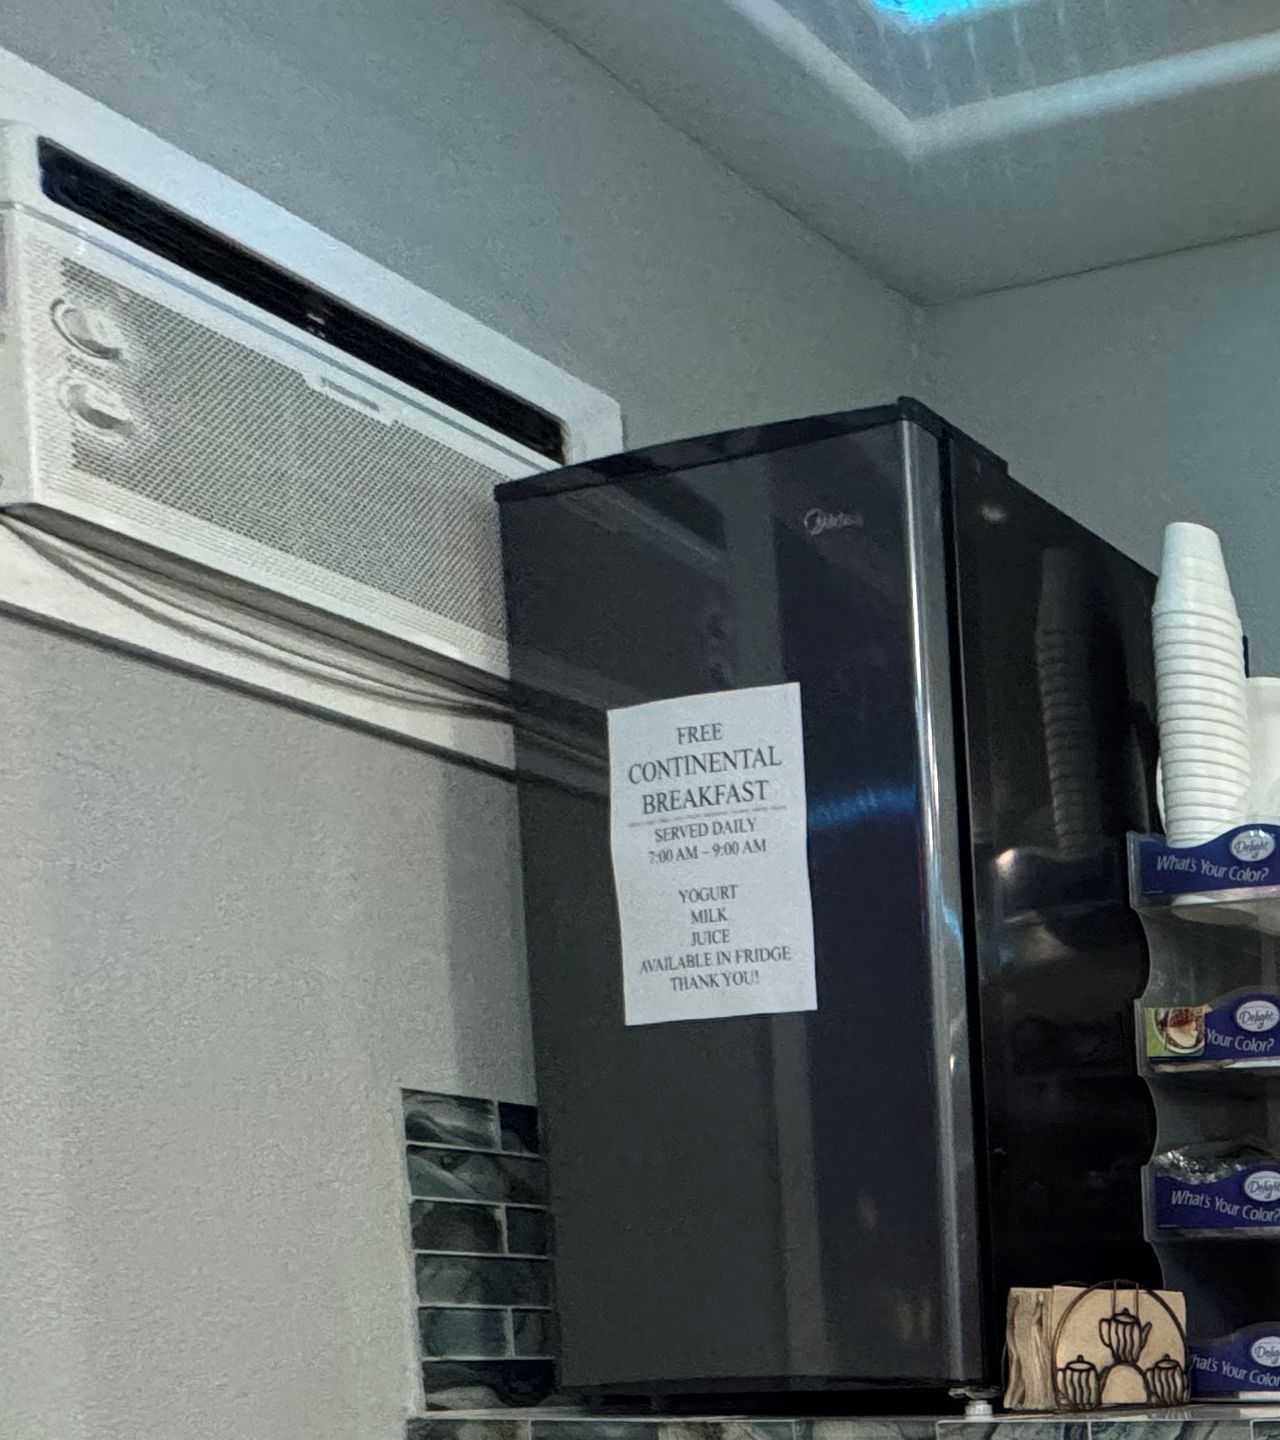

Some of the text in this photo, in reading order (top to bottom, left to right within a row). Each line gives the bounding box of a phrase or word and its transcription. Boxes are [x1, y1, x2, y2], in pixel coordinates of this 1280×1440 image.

[677, 722, 724, 745] FREE
[628, 746, 782, 784] CONTINENTAL
[642, 780, 769, 814] BREAKFAST
[655, 817, 757, 843] SERVED DAILY
[648, 849, 674, 865] 7:00
[675, 845, 699, 861] AM
[712, 841, 739, 857] 9:00
[742, 838, 767, 854] AM
[1156, 855, 1270, 883] What's Your Color?
[679, 884, 739, 904] YOGURT
[690, 907, 729, 925] MILK
[691, 929, 731, 947] JUICE
[640, 945, 792, 974] AVAILABLE IN FRIDGE
[670, 969, 760, 992] THANK YOU!
[1239, 1010, 1275, 1030] Delight
[1206, 1028, 1275, 1053] Your Color?
[1171, 1190, 1211, 1209] What's
[1213, 1197, 1241, 1216] Your
[1191, 1354, 1219, 1373] hat's
[1221, 1360, 1248, 1380] Your
